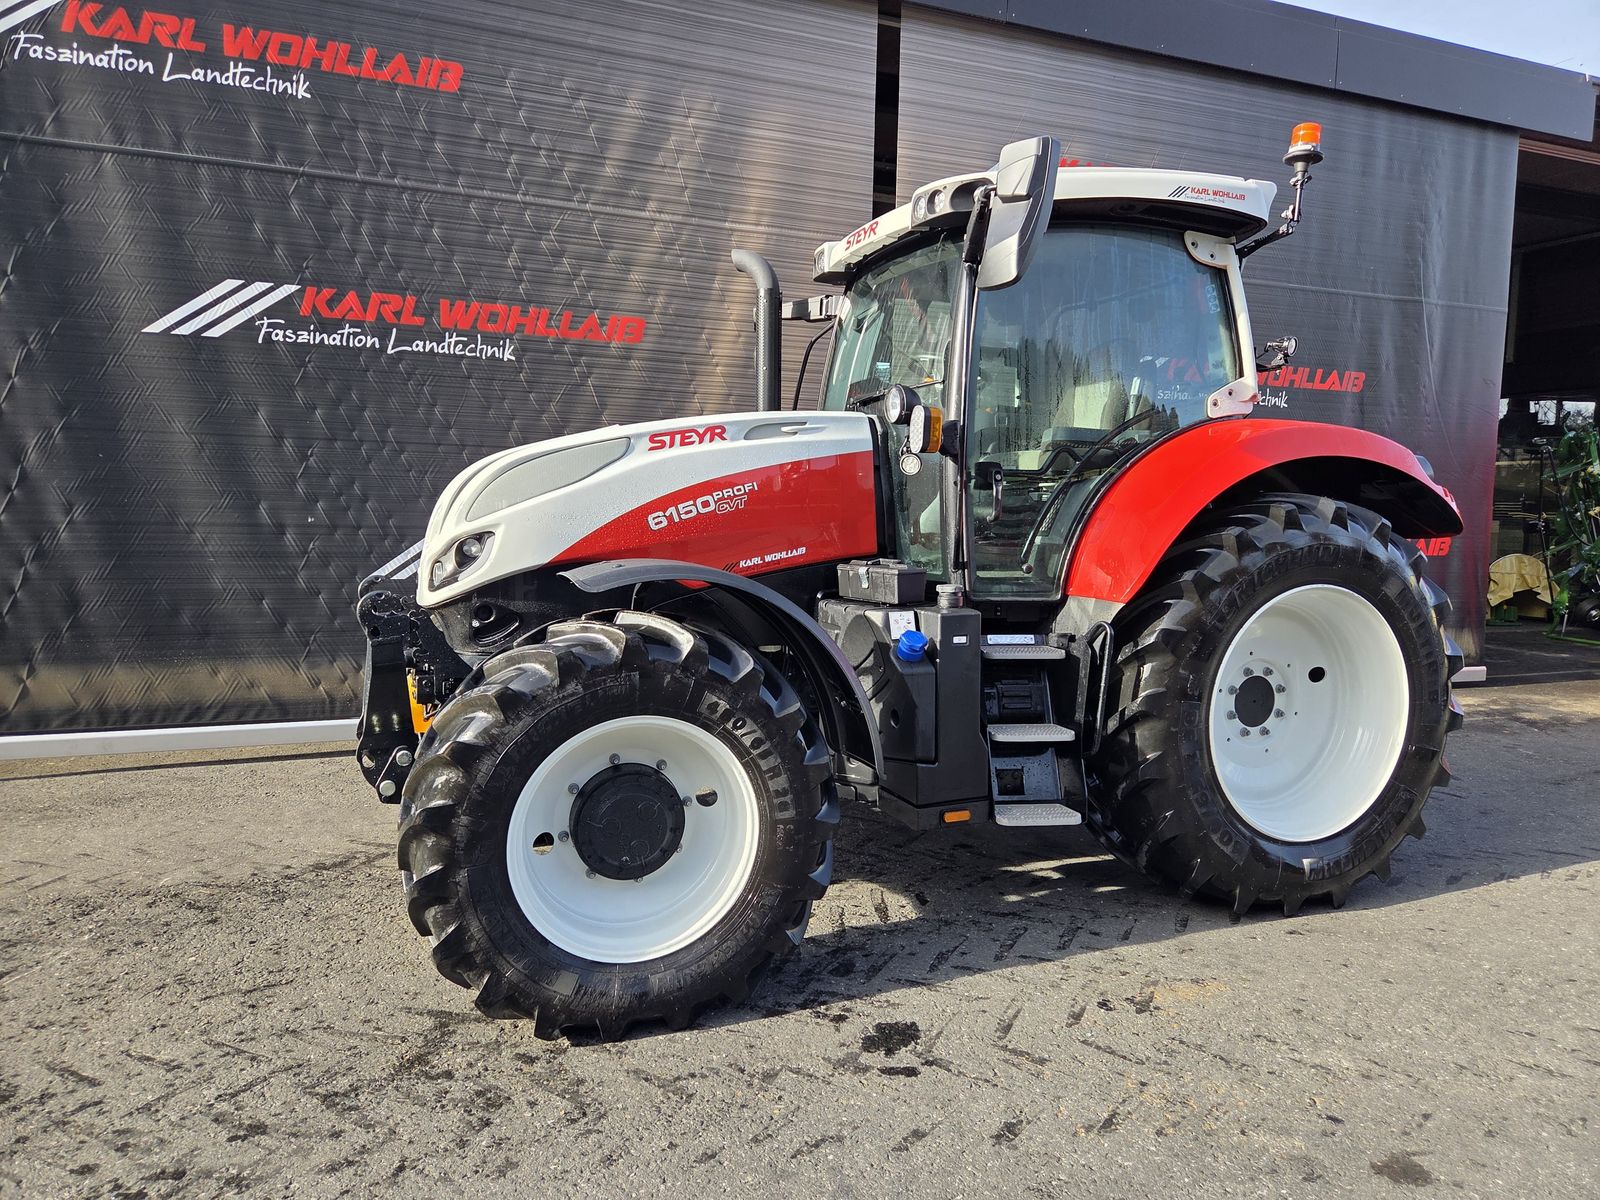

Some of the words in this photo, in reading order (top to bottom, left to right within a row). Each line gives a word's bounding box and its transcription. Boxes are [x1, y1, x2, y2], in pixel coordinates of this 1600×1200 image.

[11, 30, 154, 75] Faszination
[162, 52, 312, 99] Landtechnik
[61, 0, 206, 53] KARL
[223, 24, 464, 92] WOHLLAIB
[1191, 187, 1211, 196] KARL
[845, 220, 879, 251] STEYR
[300, 286, 426, 326] KARL
[440, 298, 647, 344] WOHLLAIB
[255, 317, 380, 349] Faszination
[387, 327, 516, 362] Landtechnik
[648, 425, 728, 452] STEYR
[647, 495, 716, 531] 6150
[712, 481, 759, 502] PROFI
[716, 495, 748, 514] CVT
[739, 556, 764, 568] KARL
[764, 546, 807, 563] WOHLLAIB
